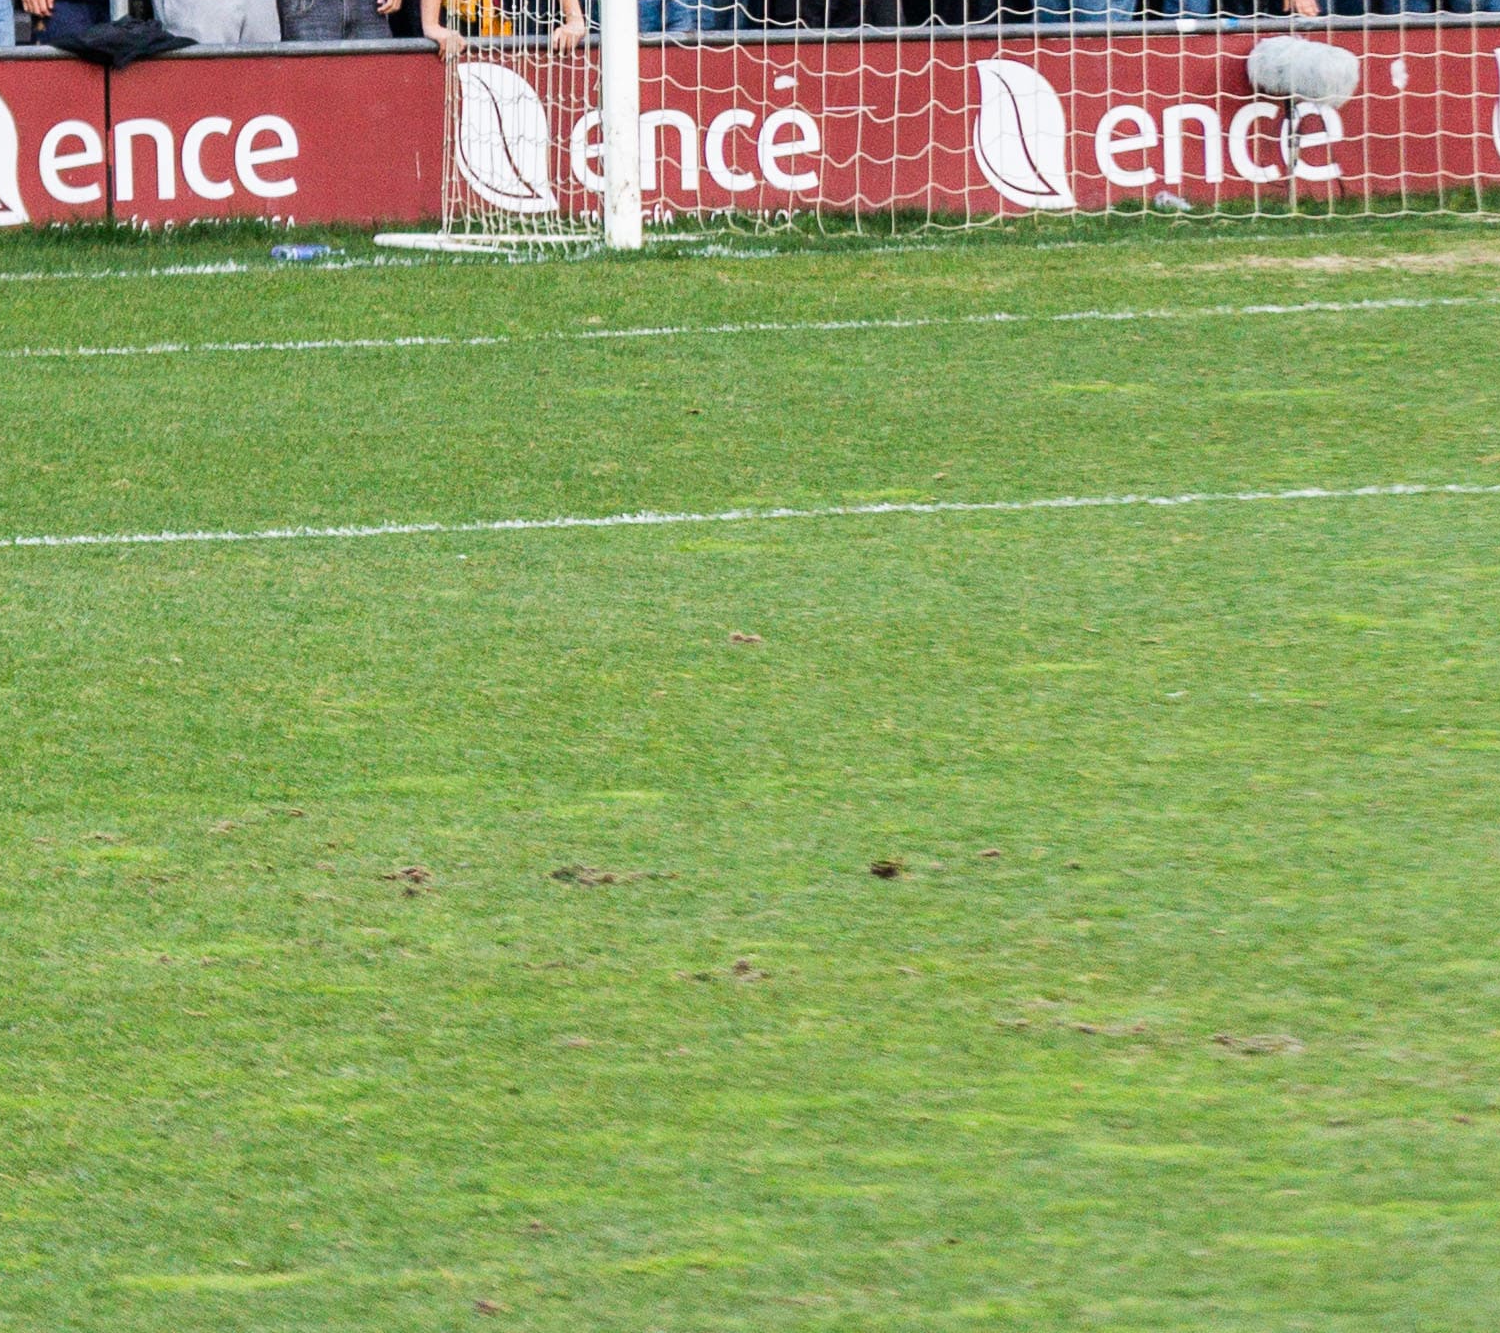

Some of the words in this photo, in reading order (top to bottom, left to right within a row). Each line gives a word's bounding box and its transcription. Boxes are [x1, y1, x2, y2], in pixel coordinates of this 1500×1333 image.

[38, 114, 300, 203] ence
[570, 108, 821, 192] ence
[1096, 100, 1343, 188] ence
